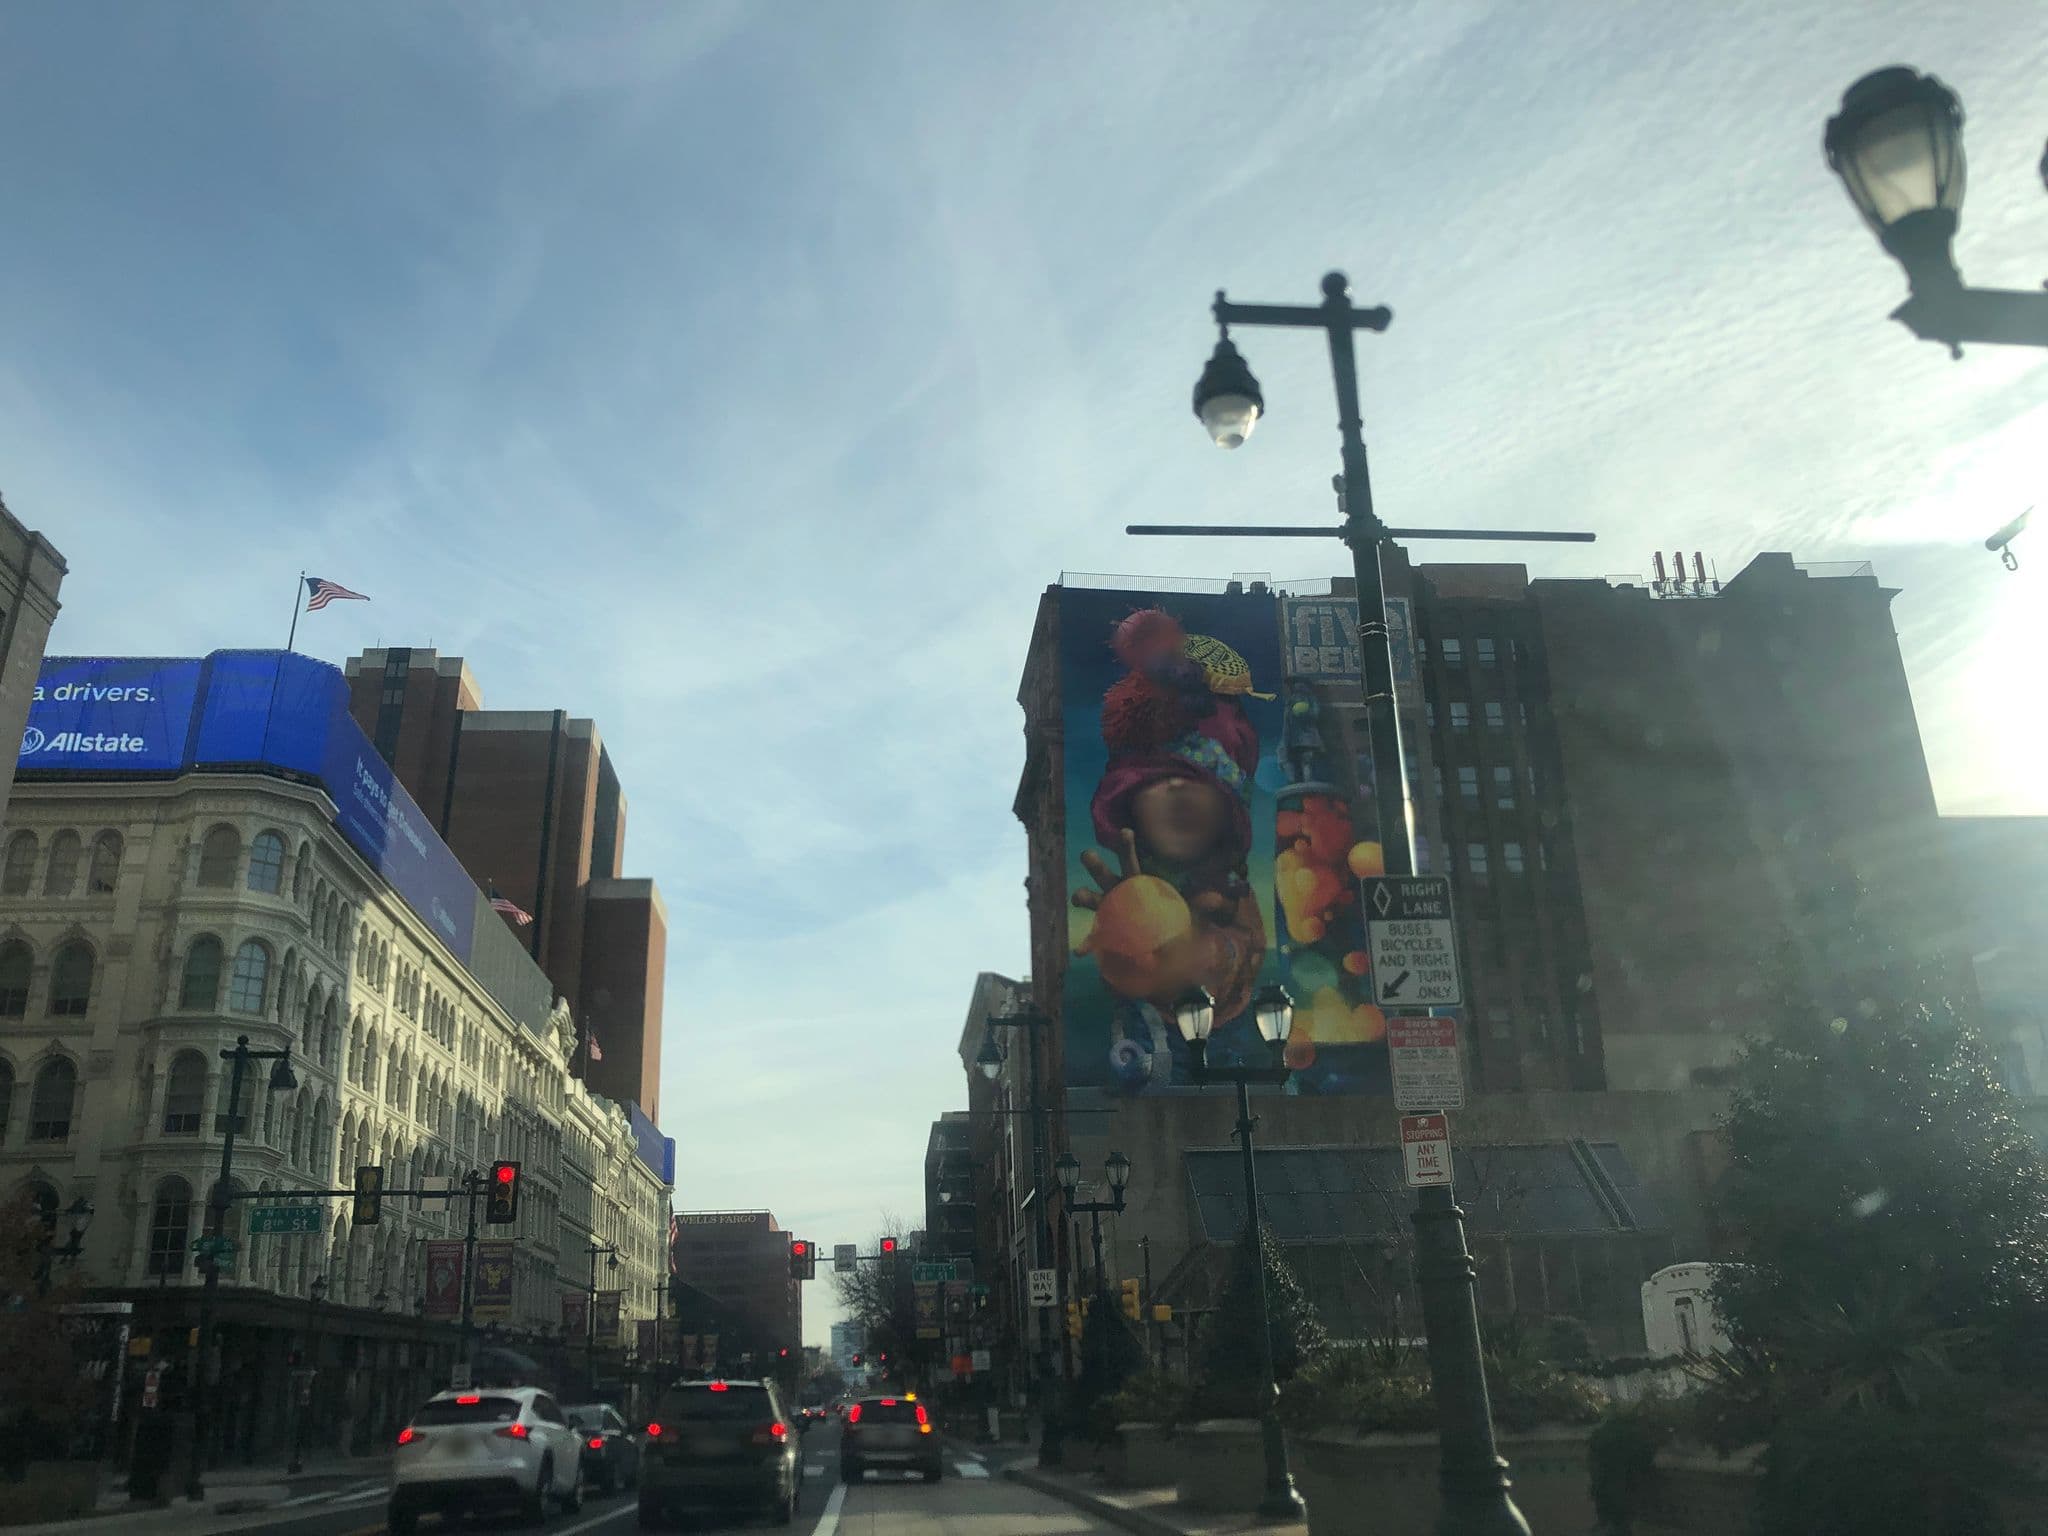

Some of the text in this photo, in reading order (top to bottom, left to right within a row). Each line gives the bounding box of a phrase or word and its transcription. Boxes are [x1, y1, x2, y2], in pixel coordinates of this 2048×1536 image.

[54, 683, 156, 702] drivers.
[44, 732, 145, 752] Allstate
[1401, 883, 1442, 896] RIGHT
[1403, 901, 1442, 914] LANE
[1388, 923, 1432, 936] BUSES
[1380, 938, 1444, 951] BICYCLES
[1379, 953, 1449, 967] AND RIGHT
[1417, 970, 1452, 982] TURN
[1418, 986, 1452, 999] ONLY
[1406, 1128, 1445, 1140] STOPPING
[1417, 1143, 1436, 1156] ANY
[1417, 1156, 1440, 1169] TIME
[679, 1214, 757, 1225] WELLS FARGO
[1033, 1271, 1052, 1281] ONE
[1033, 1282, 1052, 1291] WAY
